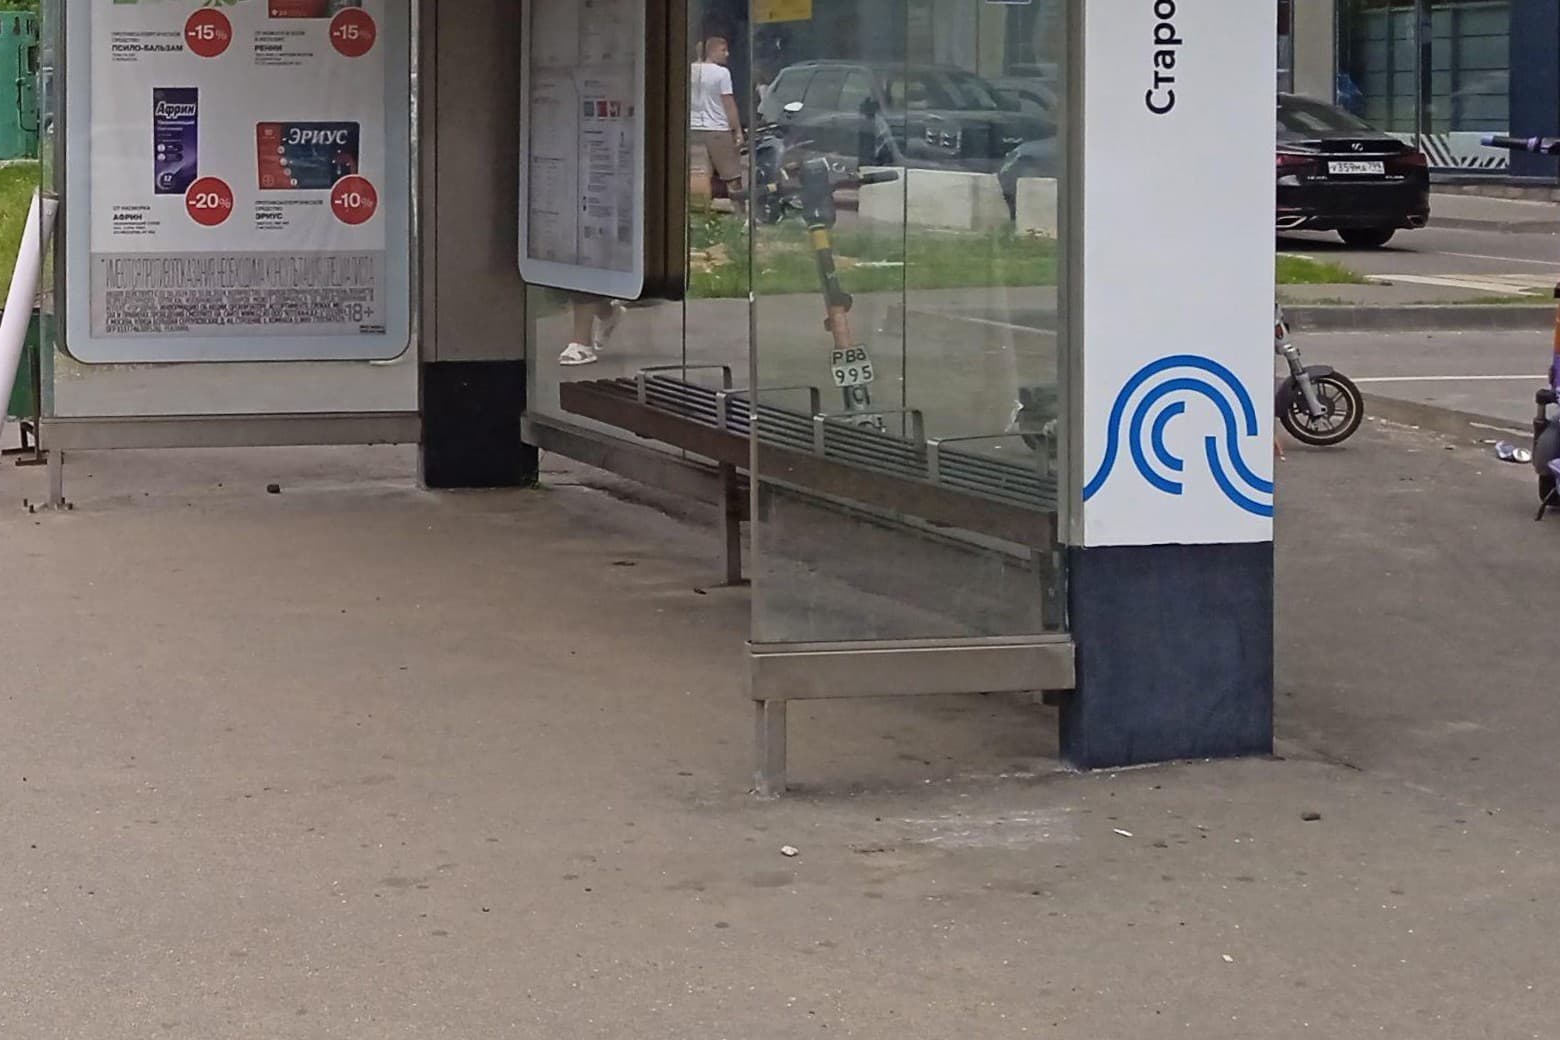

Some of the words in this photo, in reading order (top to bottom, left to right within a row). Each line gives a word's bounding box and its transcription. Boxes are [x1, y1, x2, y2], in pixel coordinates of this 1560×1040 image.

[112, 44, 183, 52] ПСИЛО-БАЛЬЗАМ
[155, 101, 197, 119] Африн
[288, 128, 348, 145] ЭРИУС
[189, 192, 231, 209] -20%
[344, 303, 374, 321] 18+
[834, 364, 872, 384] 995
